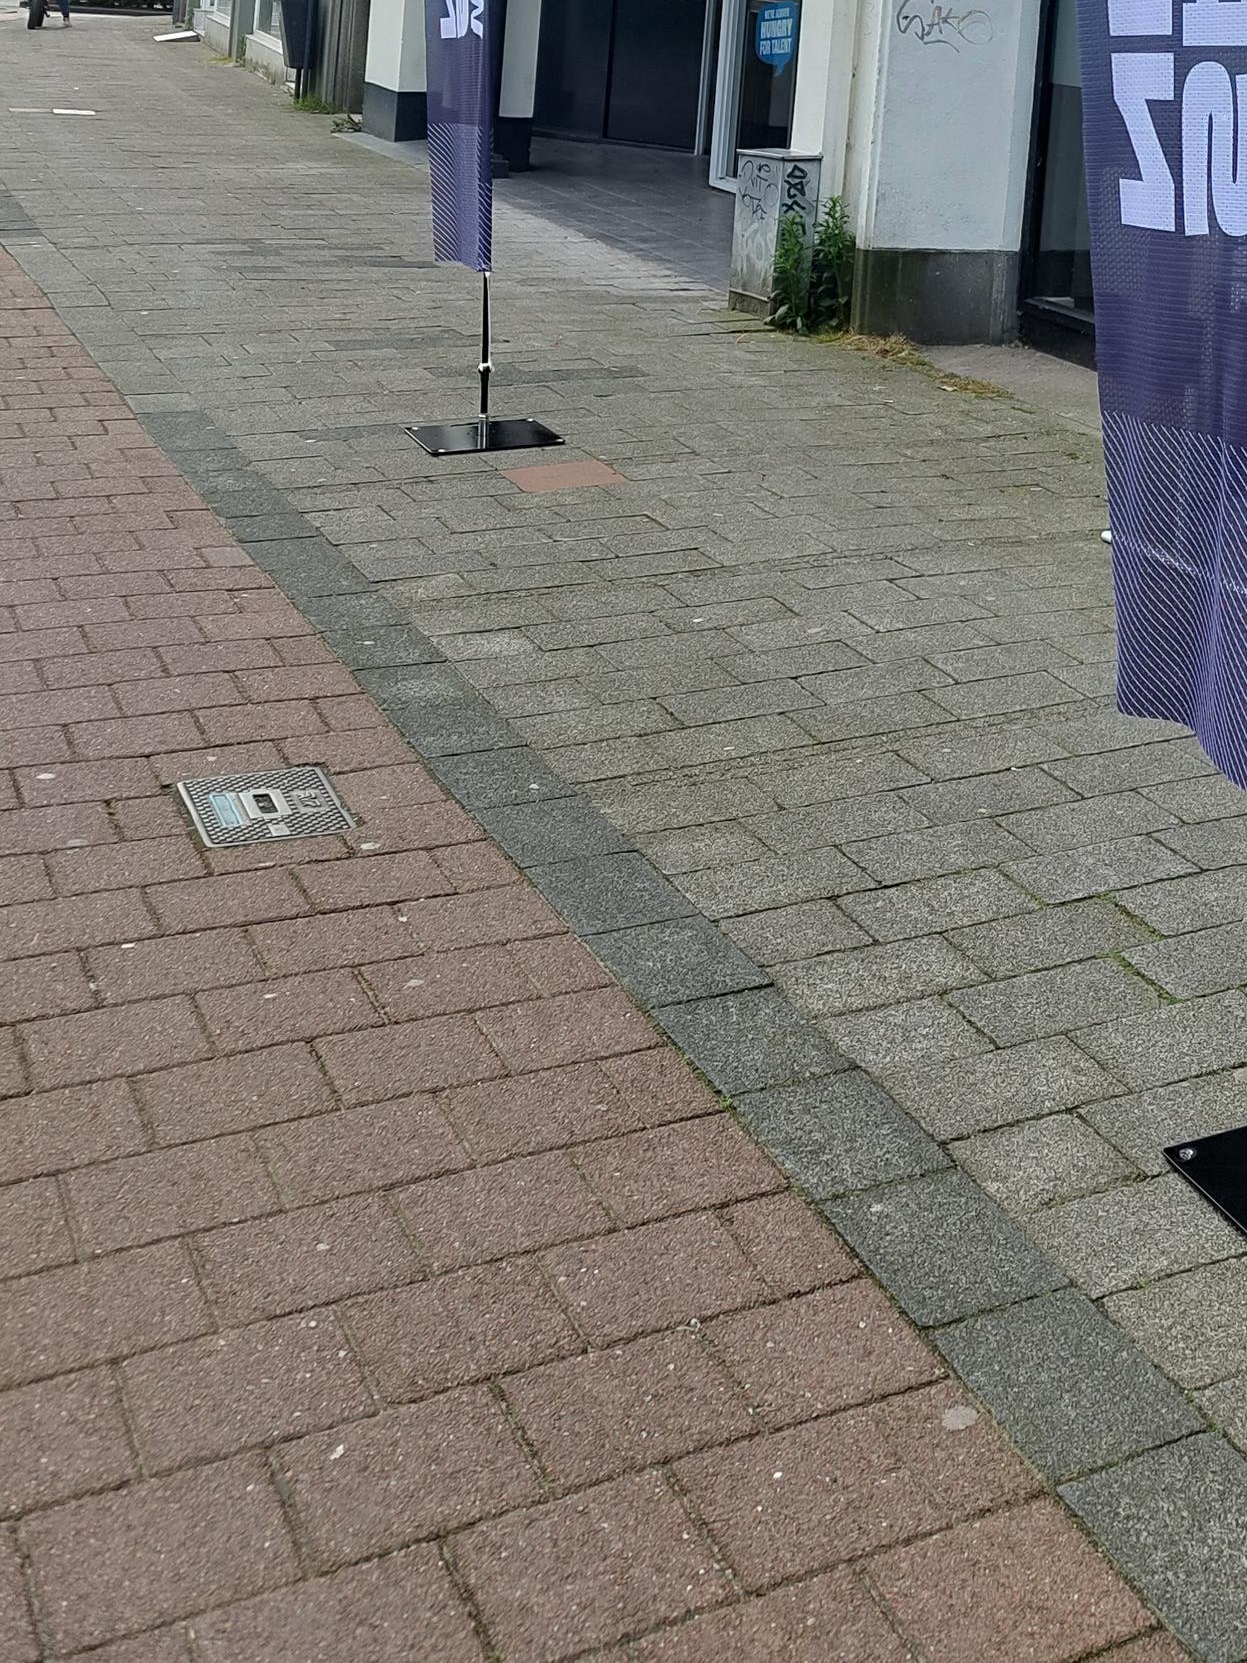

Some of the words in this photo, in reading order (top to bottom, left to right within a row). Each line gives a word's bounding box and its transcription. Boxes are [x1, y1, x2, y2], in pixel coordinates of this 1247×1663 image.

[760, 18, 793, 39] HUNGRY
[759, 40, 771, 56] FOR
[771, 38, 792, 54] TALENT
